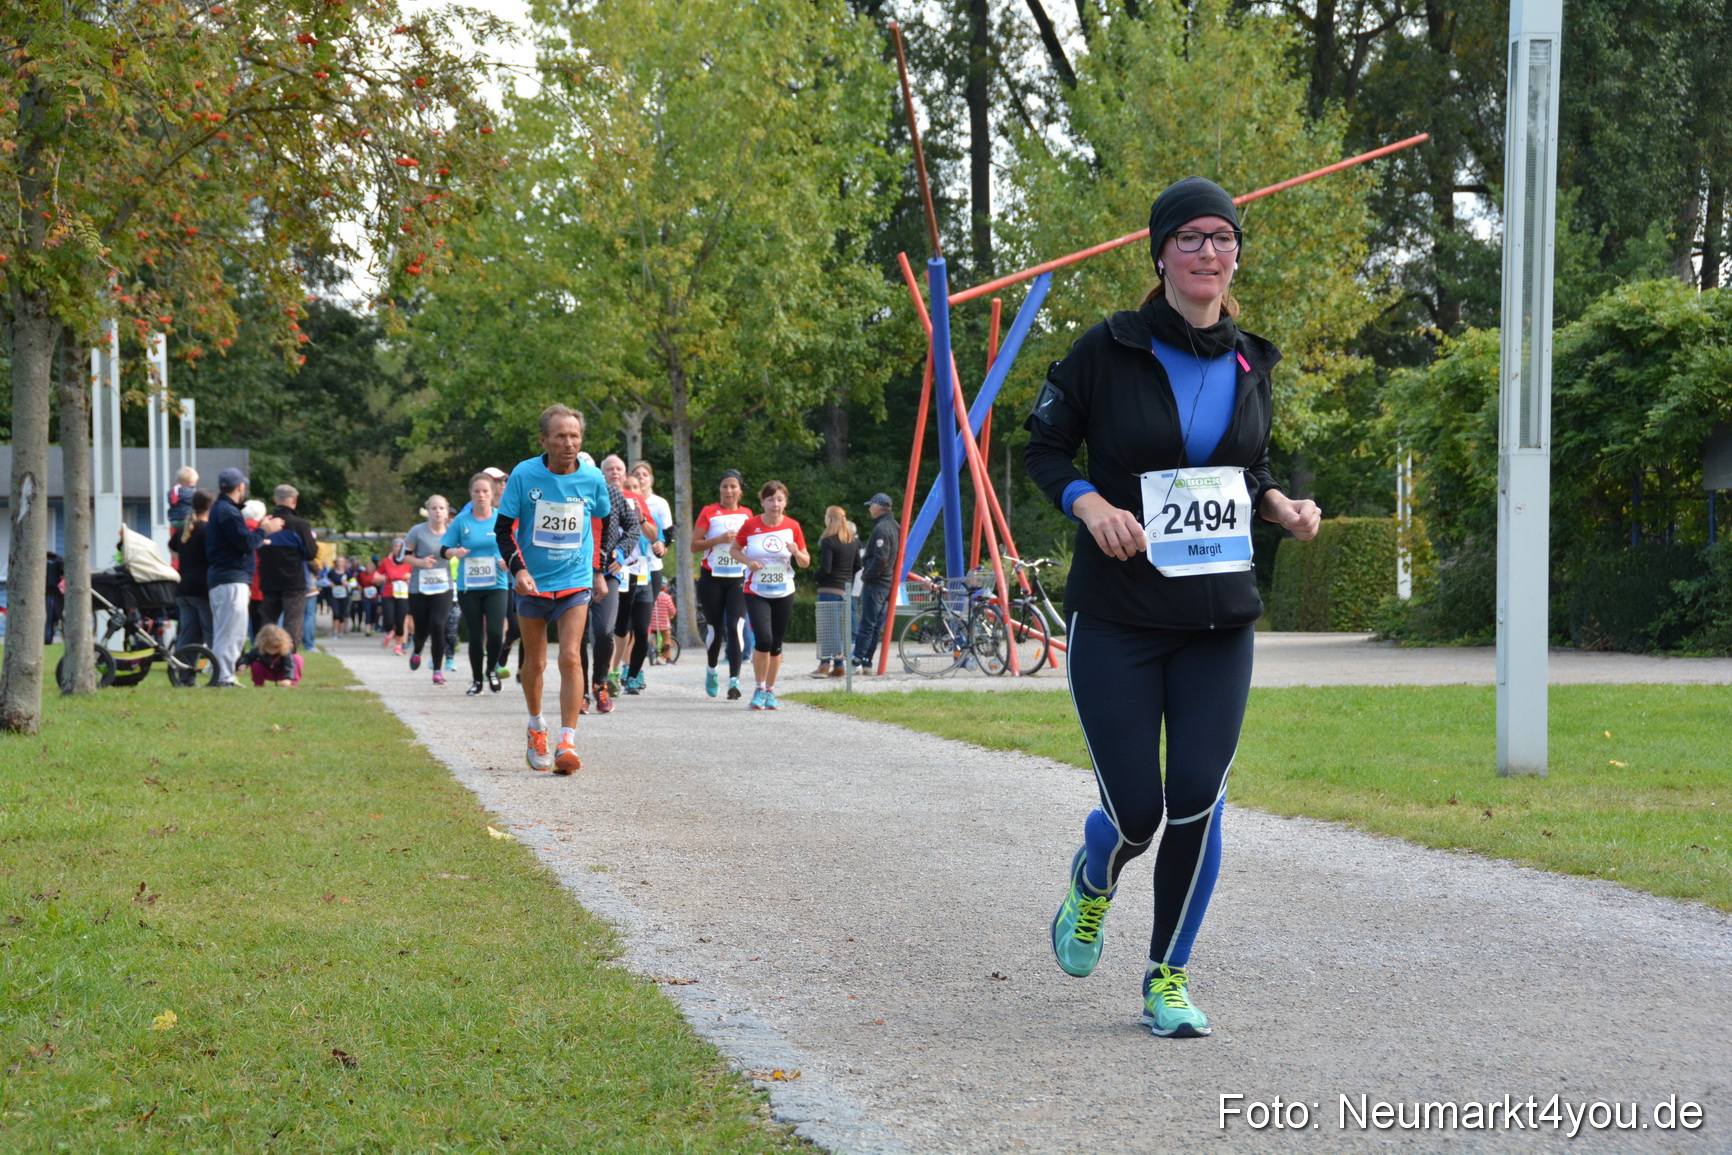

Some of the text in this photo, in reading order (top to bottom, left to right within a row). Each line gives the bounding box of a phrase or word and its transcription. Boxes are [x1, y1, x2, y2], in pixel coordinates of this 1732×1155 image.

[1187, 477, 1221, 487] BOCK
[542, 515, 577, 531] 2316
[1162, 499, 1237, 535] 2494
[1188, 543, 1222, 557] Margit
[469, 566, 491, 576] 2930
[761, 573, 784, 583] 2338
